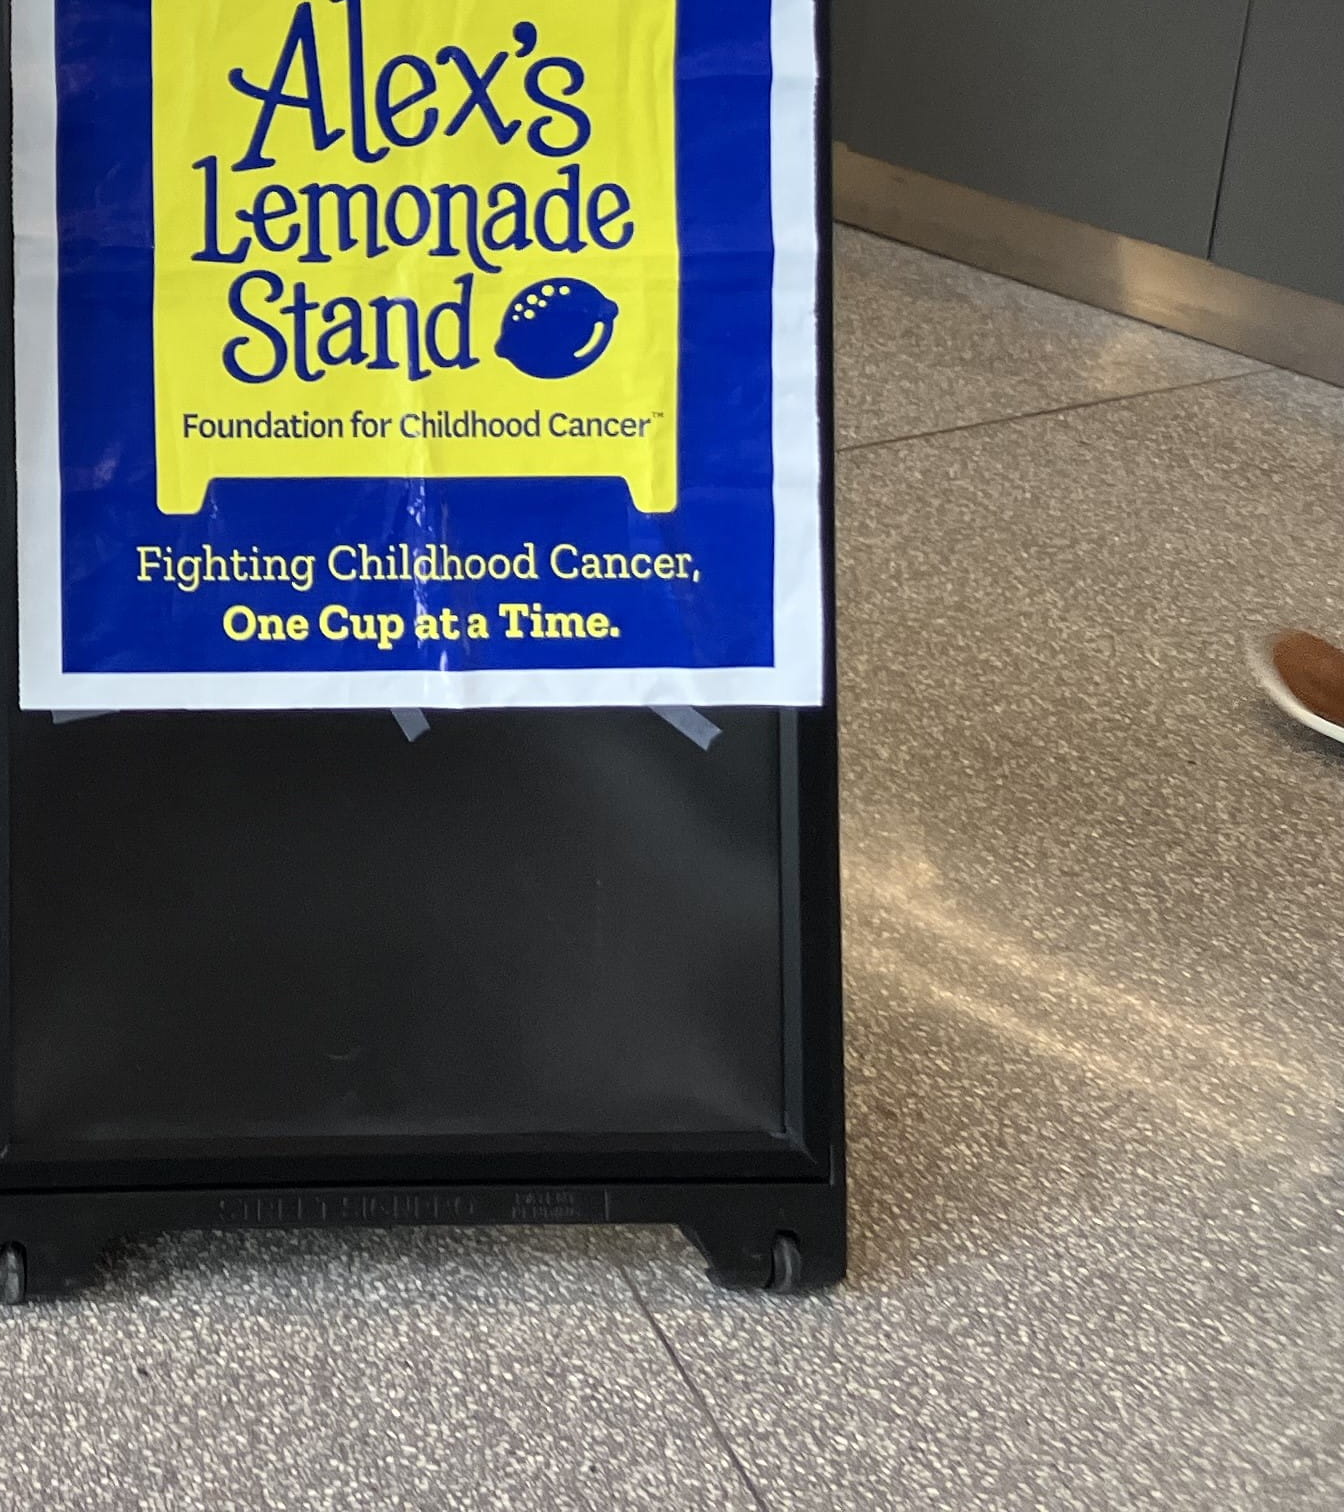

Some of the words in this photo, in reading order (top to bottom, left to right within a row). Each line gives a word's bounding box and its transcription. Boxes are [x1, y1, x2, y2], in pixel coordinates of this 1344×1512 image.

[191, 155, 634, 274] Lemonade
[222, 268, 480, 384] Stand
[183, 412, 344, 439] Foundation
[350, 410, 392, 438] for
[400, 410, 540, 439] Childhood
[136, 545, 315, 591] Fighting
[328, 542, 538, 582] Childhood
[550, 543, 702, 584] Cancer,
[222, 604, 309, 640] One
[319, 604, 404, 649] Cup
[415, 606, 460, 640] at
[466, 613, 488, 639] a
[499, 603, 620, 639] Time.
